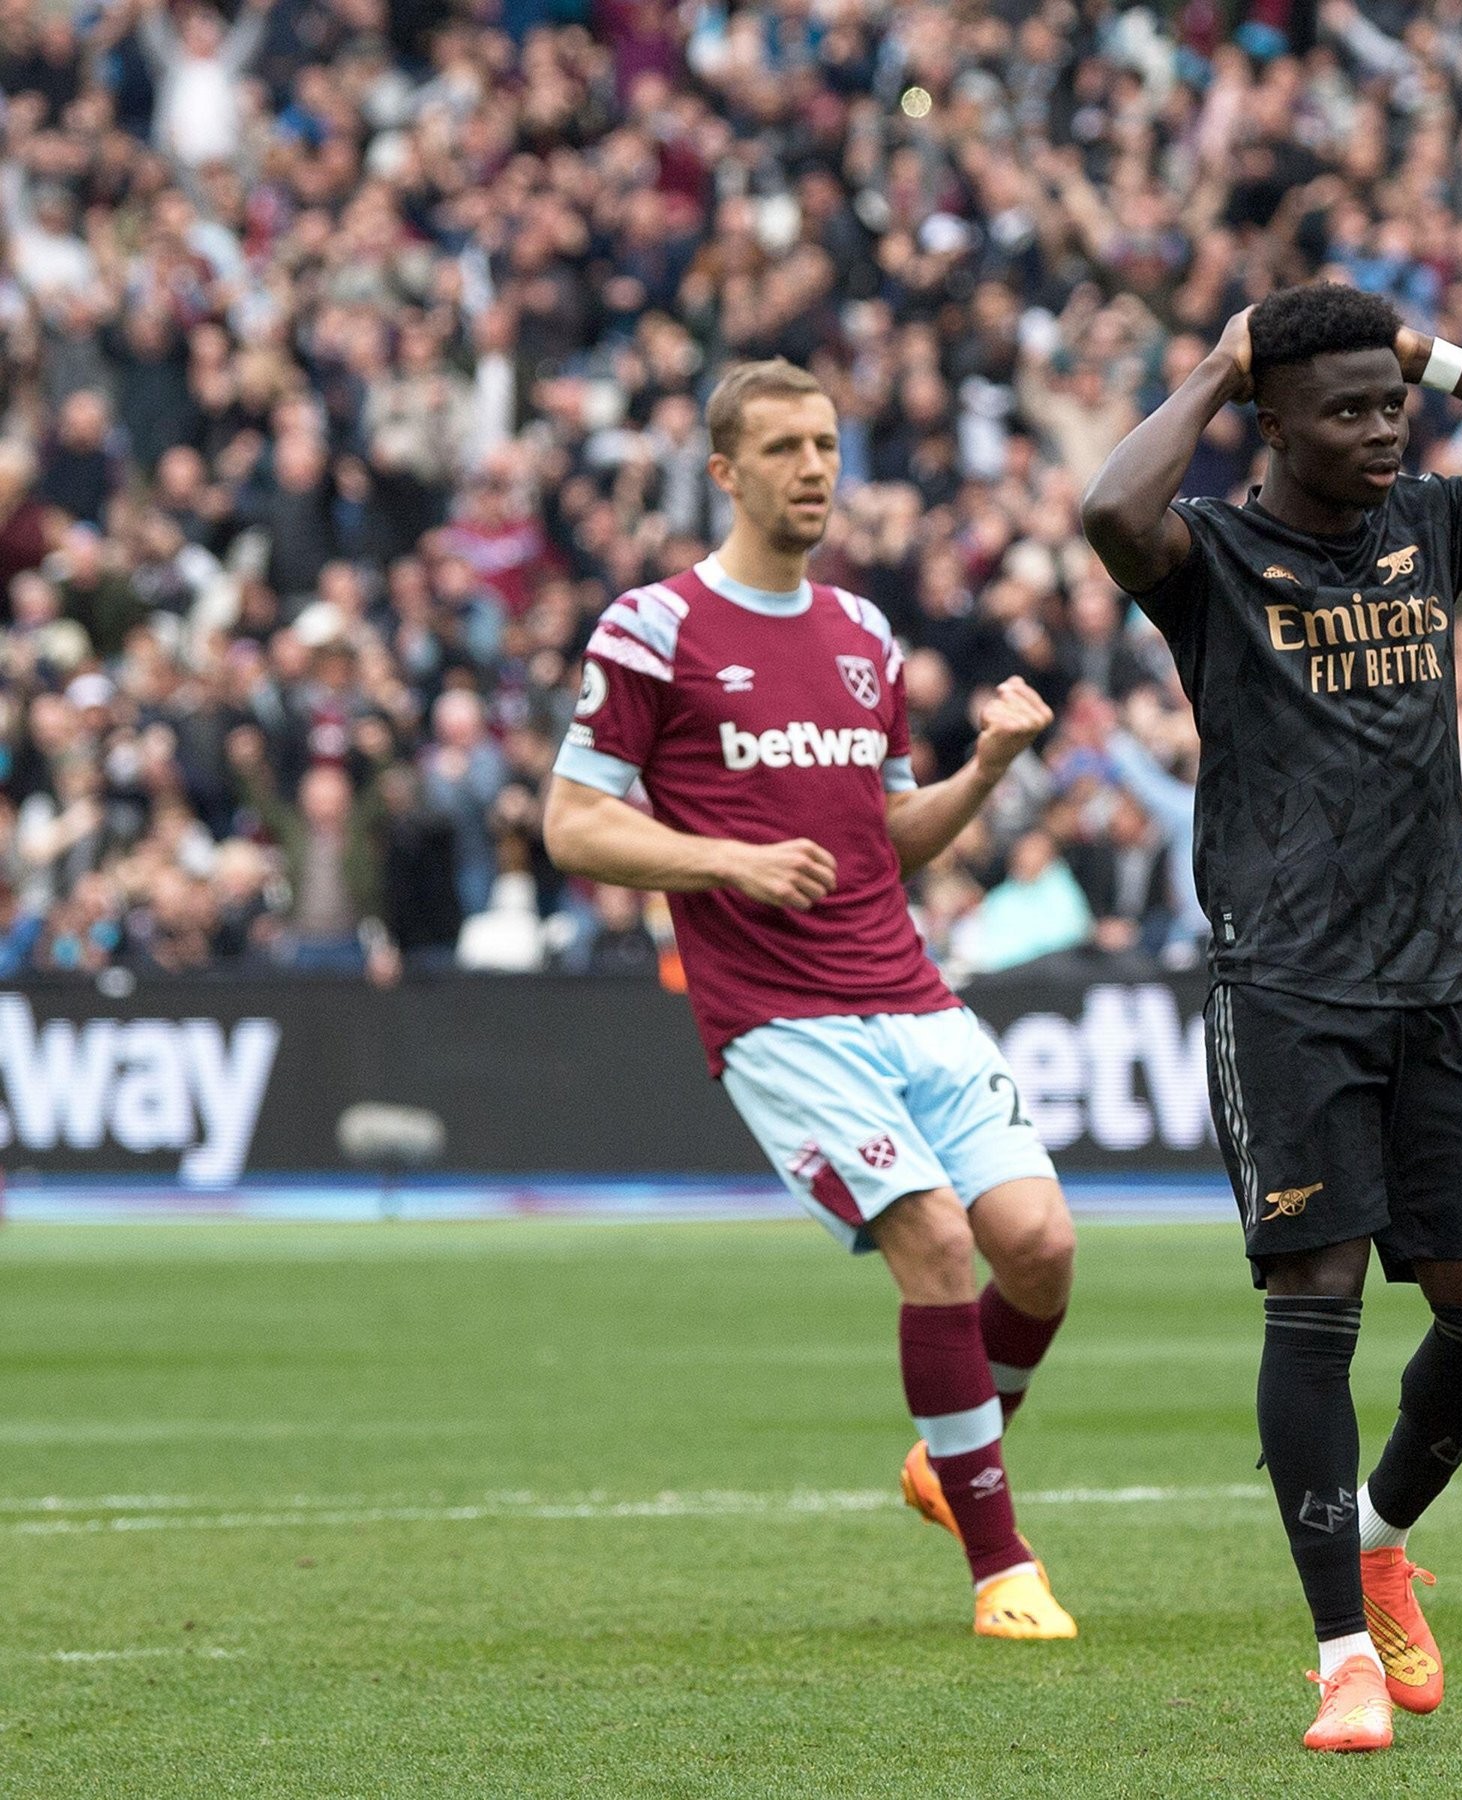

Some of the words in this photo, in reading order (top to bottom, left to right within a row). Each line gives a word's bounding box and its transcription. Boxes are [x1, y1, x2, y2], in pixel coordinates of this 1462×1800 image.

[1264, 592, 1449, 651] Emirates
[1310, 651, 1356, 693] FLY
[1366, 643, 1443, 687] BETTER
[0, 992, 282, 1190] way
